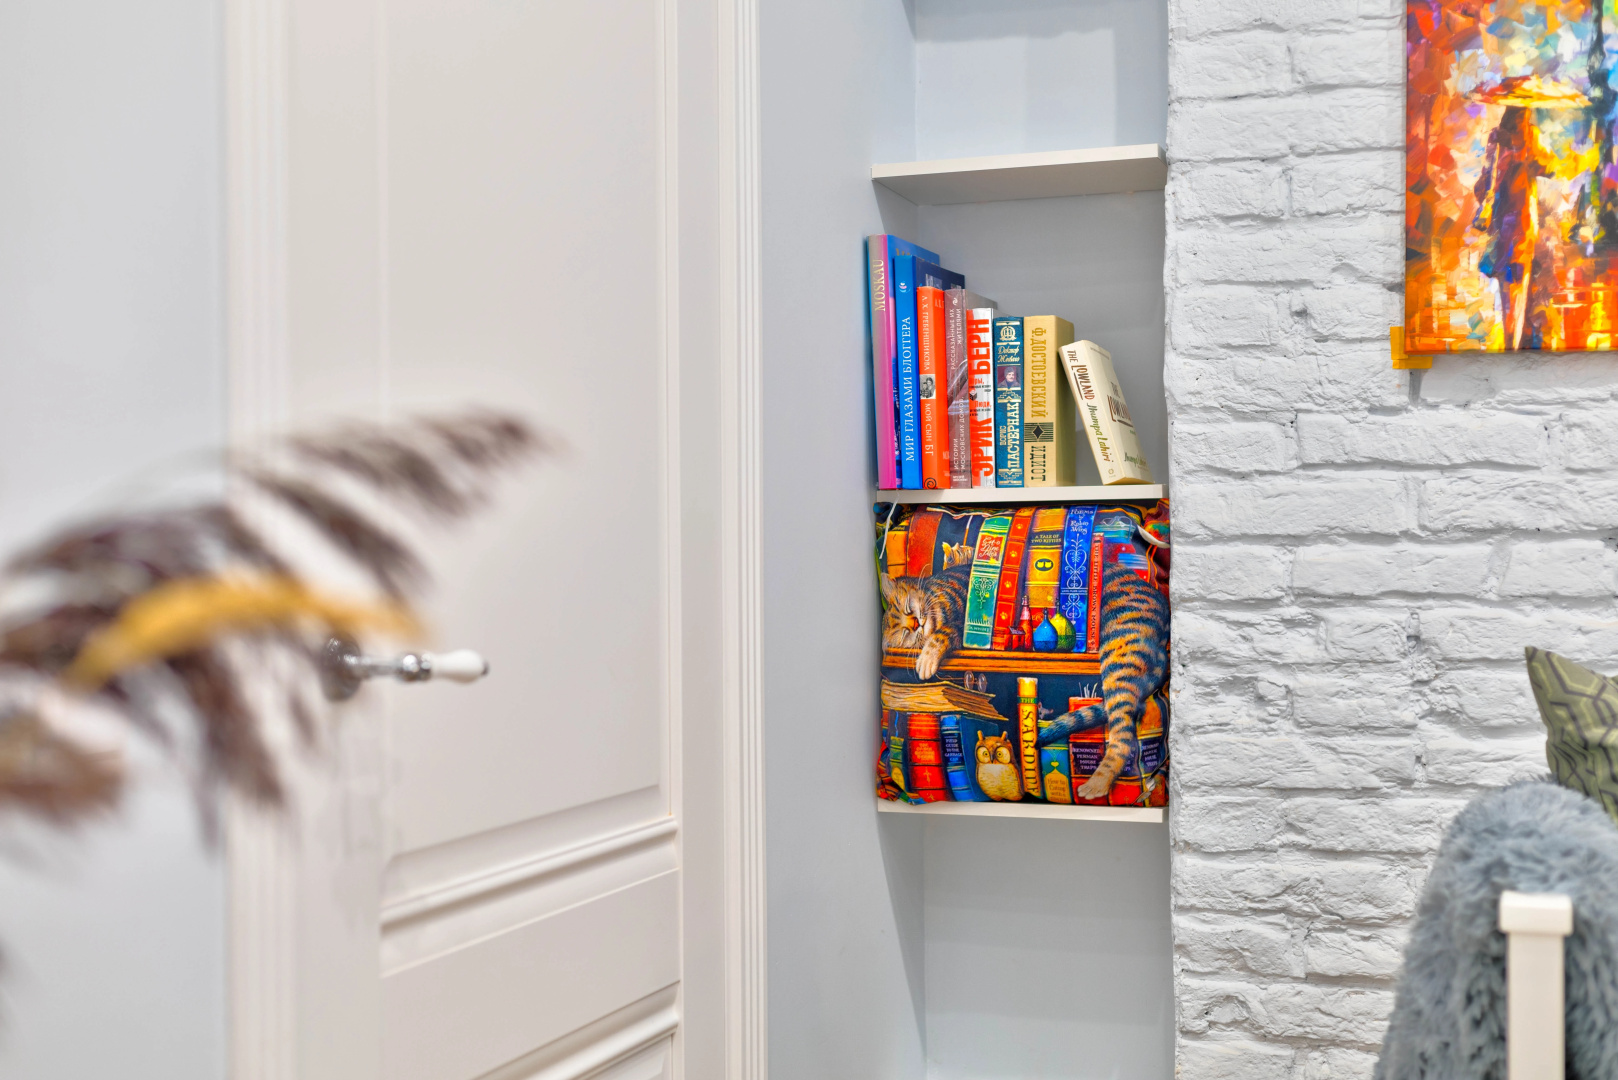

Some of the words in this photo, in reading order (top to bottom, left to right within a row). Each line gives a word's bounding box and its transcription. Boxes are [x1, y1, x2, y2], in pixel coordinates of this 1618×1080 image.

[873, 259, 886, 312] MOSKAU
[949, 308, 955, 318] ИХ
[902, 316, 912, 373] БЛОГГЕРА
[922, 311, 931, 371] ГРЕБЕНЩИКОВА
[966, 318, 991, 375] БЕРН
[1067, 350, 1078, 363] THE
[1030, 327, 1048, 418] Ф.ДОСТОЕВСКИЙ
[1071, 364, 1095, 400] LOWLAND
[903, 375, 914, 432] ГЛАЗАМИ
[925, 403, 933, 422] МОЙ
[1086, 402, 1103, 436] Jhumpa
[905, 435, 915, 461] МИР
[925, 423, 933, 442] СЫН
[925, 444, 934, 456] БГ
[969, 417, 994, 478] ЭРИК
[999, 425, 1007, 446] БОРИС
[1006, 402, 1020, 468] ПАСТЕРНАК
[1097, 437, 1114, 463] Lahiri
[1030, 445, 1046, 481] ИДИОТ
